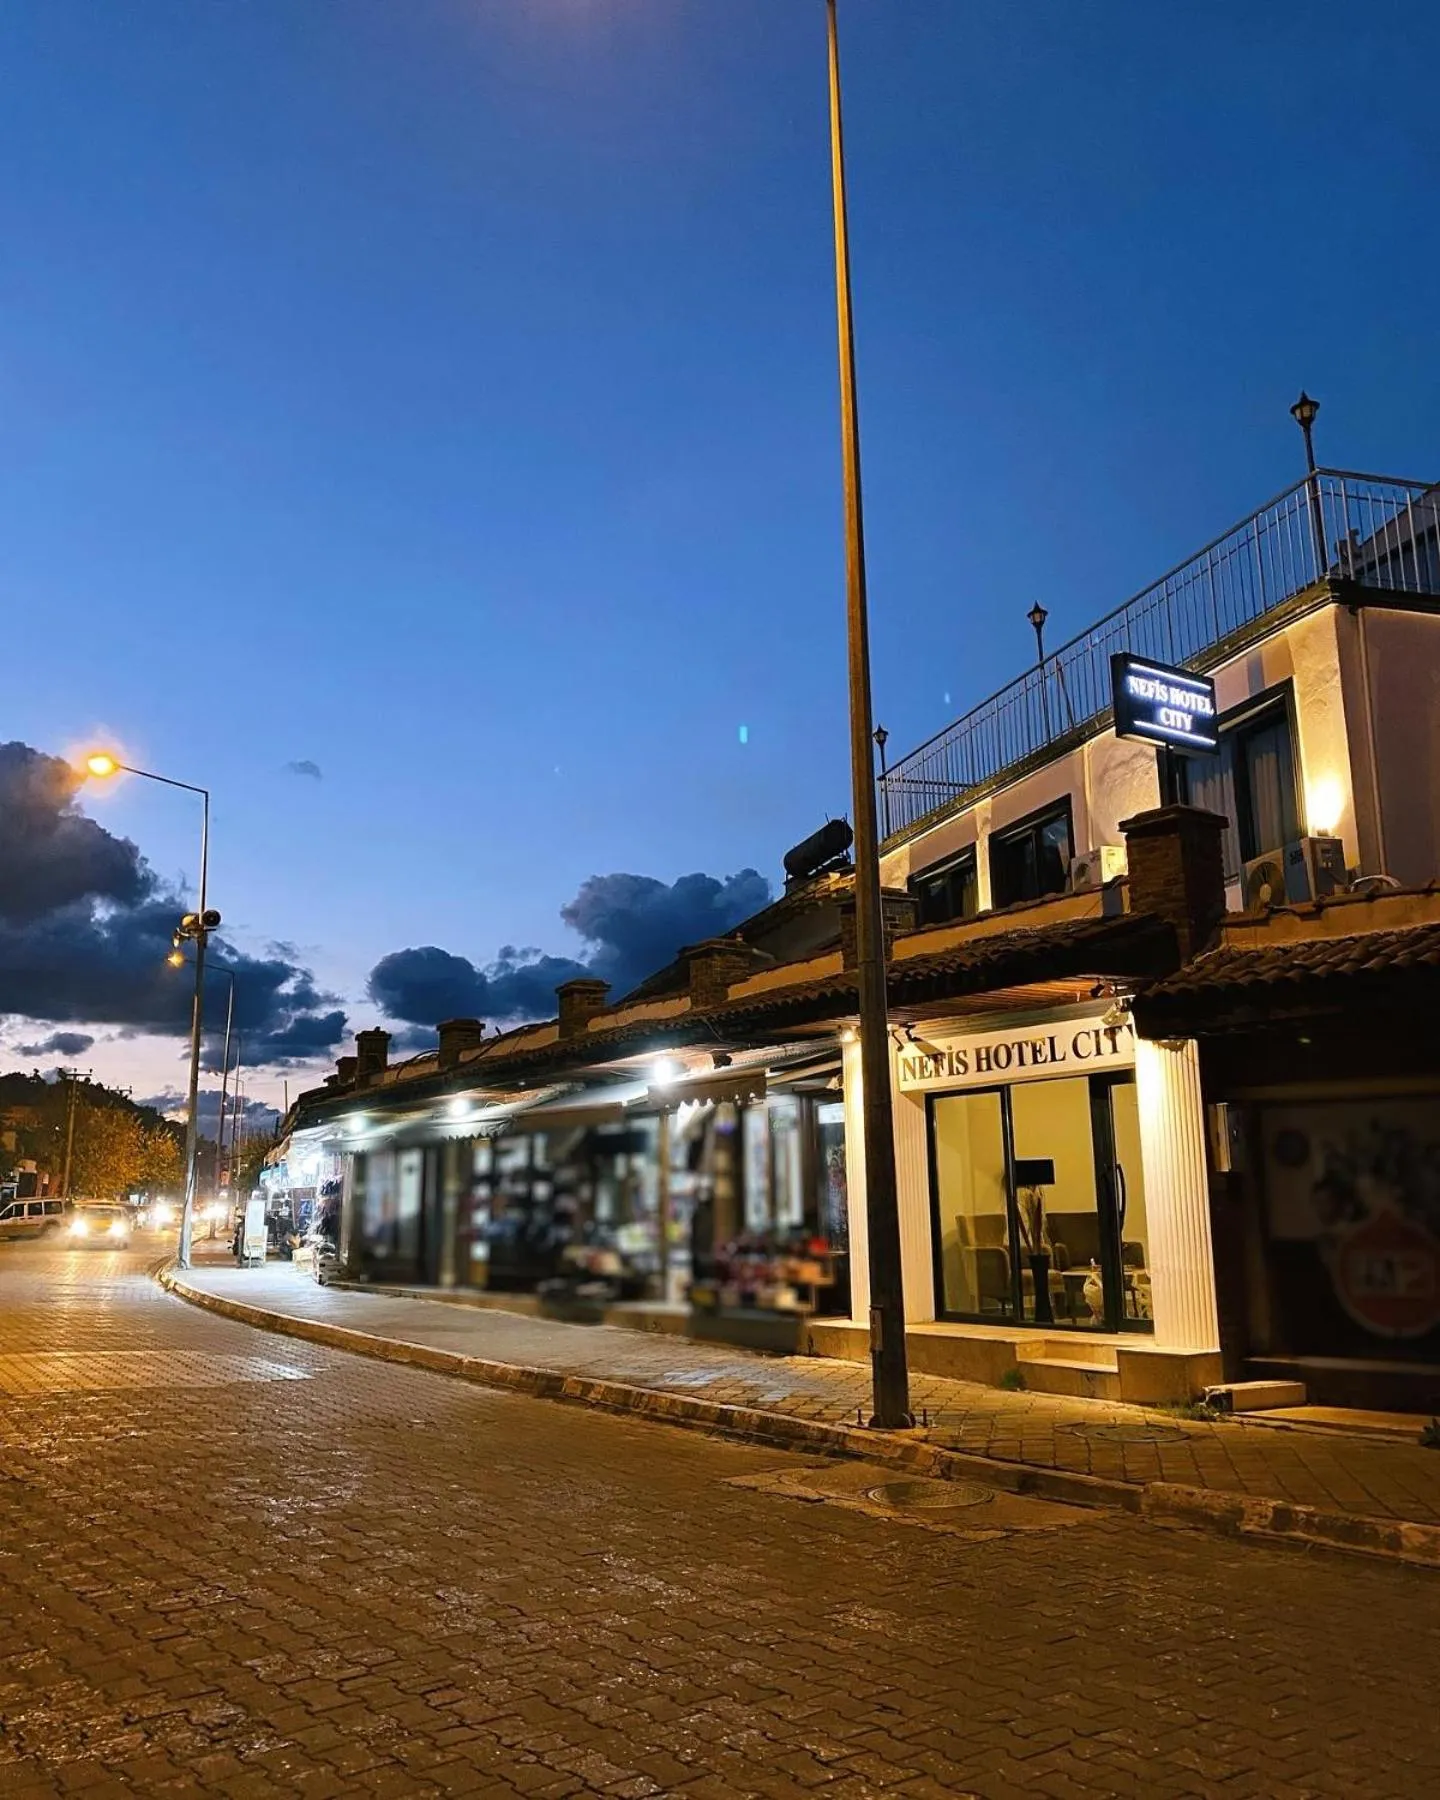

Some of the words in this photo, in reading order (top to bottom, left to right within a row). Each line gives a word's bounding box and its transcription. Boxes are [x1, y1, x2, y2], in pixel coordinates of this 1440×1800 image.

[1169, 687, 1215, 715] HOTEL
[1160, 708, 1192, 731] CITY
[901, 1045, 969, 1082] NEFİS
[975, 1035, 1066, 1073] HOTEL
